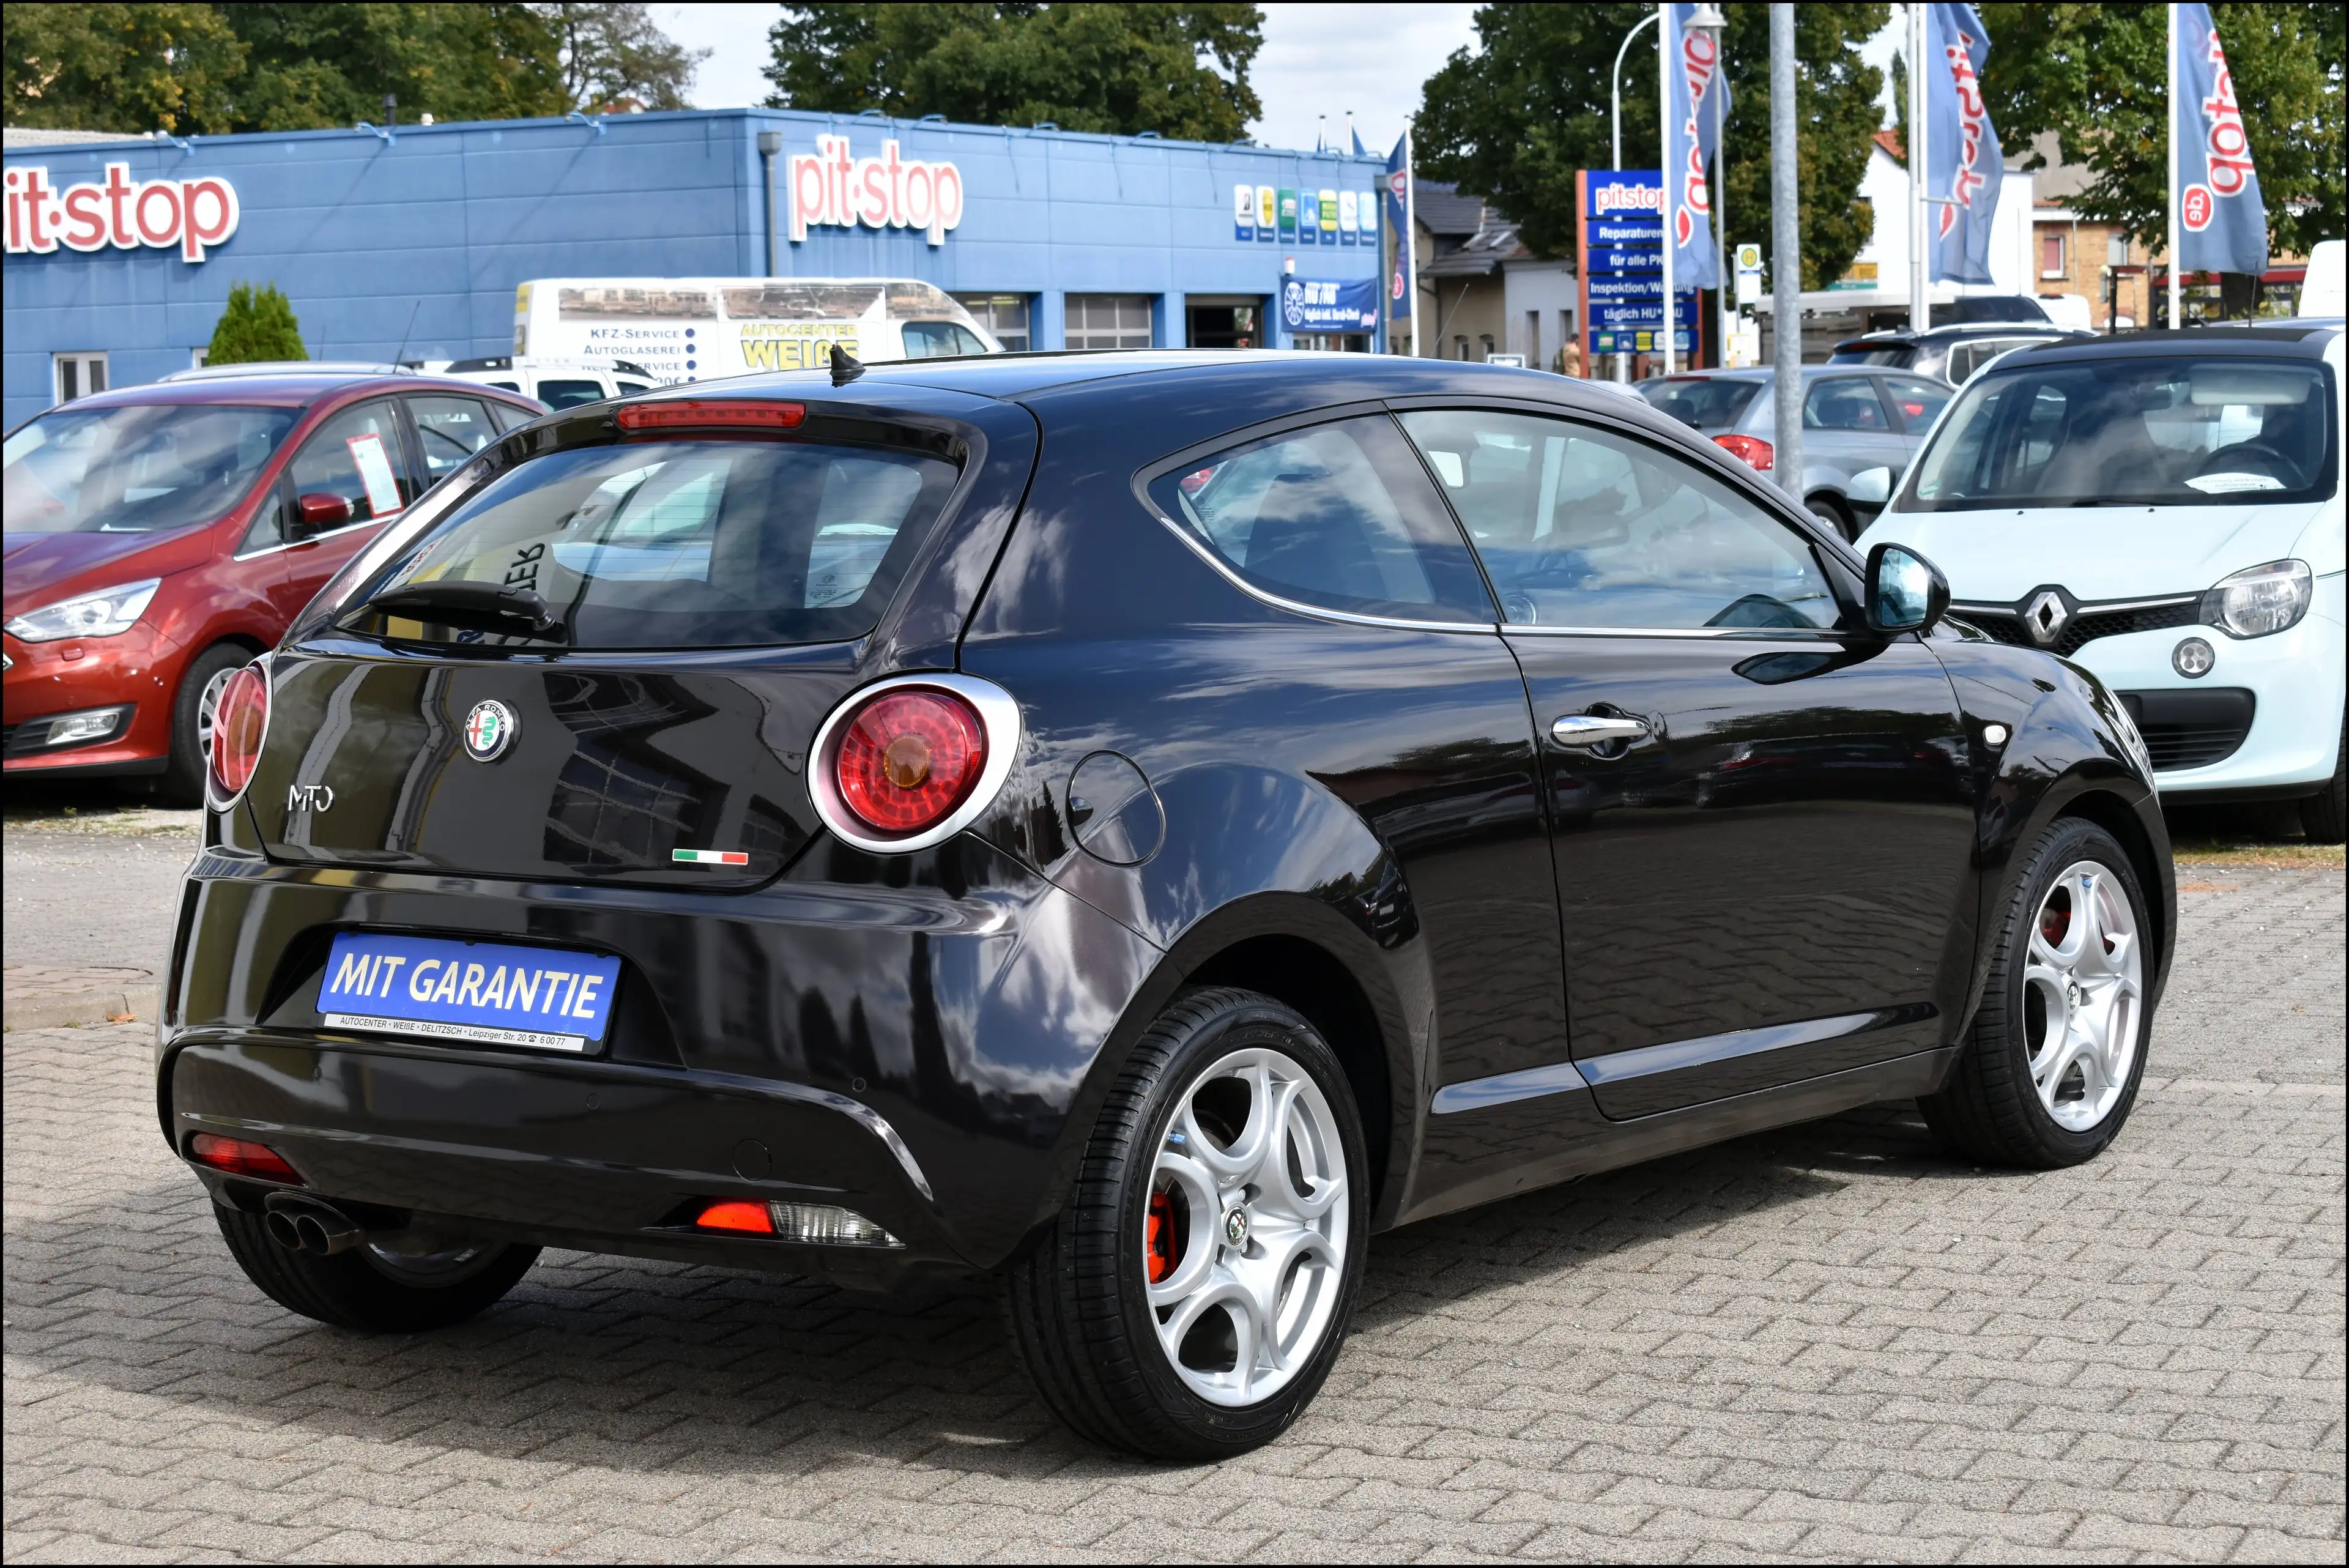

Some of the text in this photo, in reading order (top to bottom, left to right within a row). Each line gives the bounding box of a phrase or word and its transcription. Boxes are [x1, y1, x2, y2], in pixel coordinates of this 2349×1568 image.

[1599, 227, 1663, 240] Reparaturen
[1610, 254, 1663, 266] für alle PK
[1604, 307, 1639, 321] täglich
[741, 324, 858, 336] AUTOCENTER
[466, 704, 505, 731] ALFA ROMEO
[330, 953, 603, 1019] MIT GARANTIE
[340, 1017, 387, 1028] AUTOCENTER
[421, 1024, 462, 1035] DELITZSCH
[469, 1028, 501, 1040] Leipziger
[503, 1031, 515, 1041] Str.
